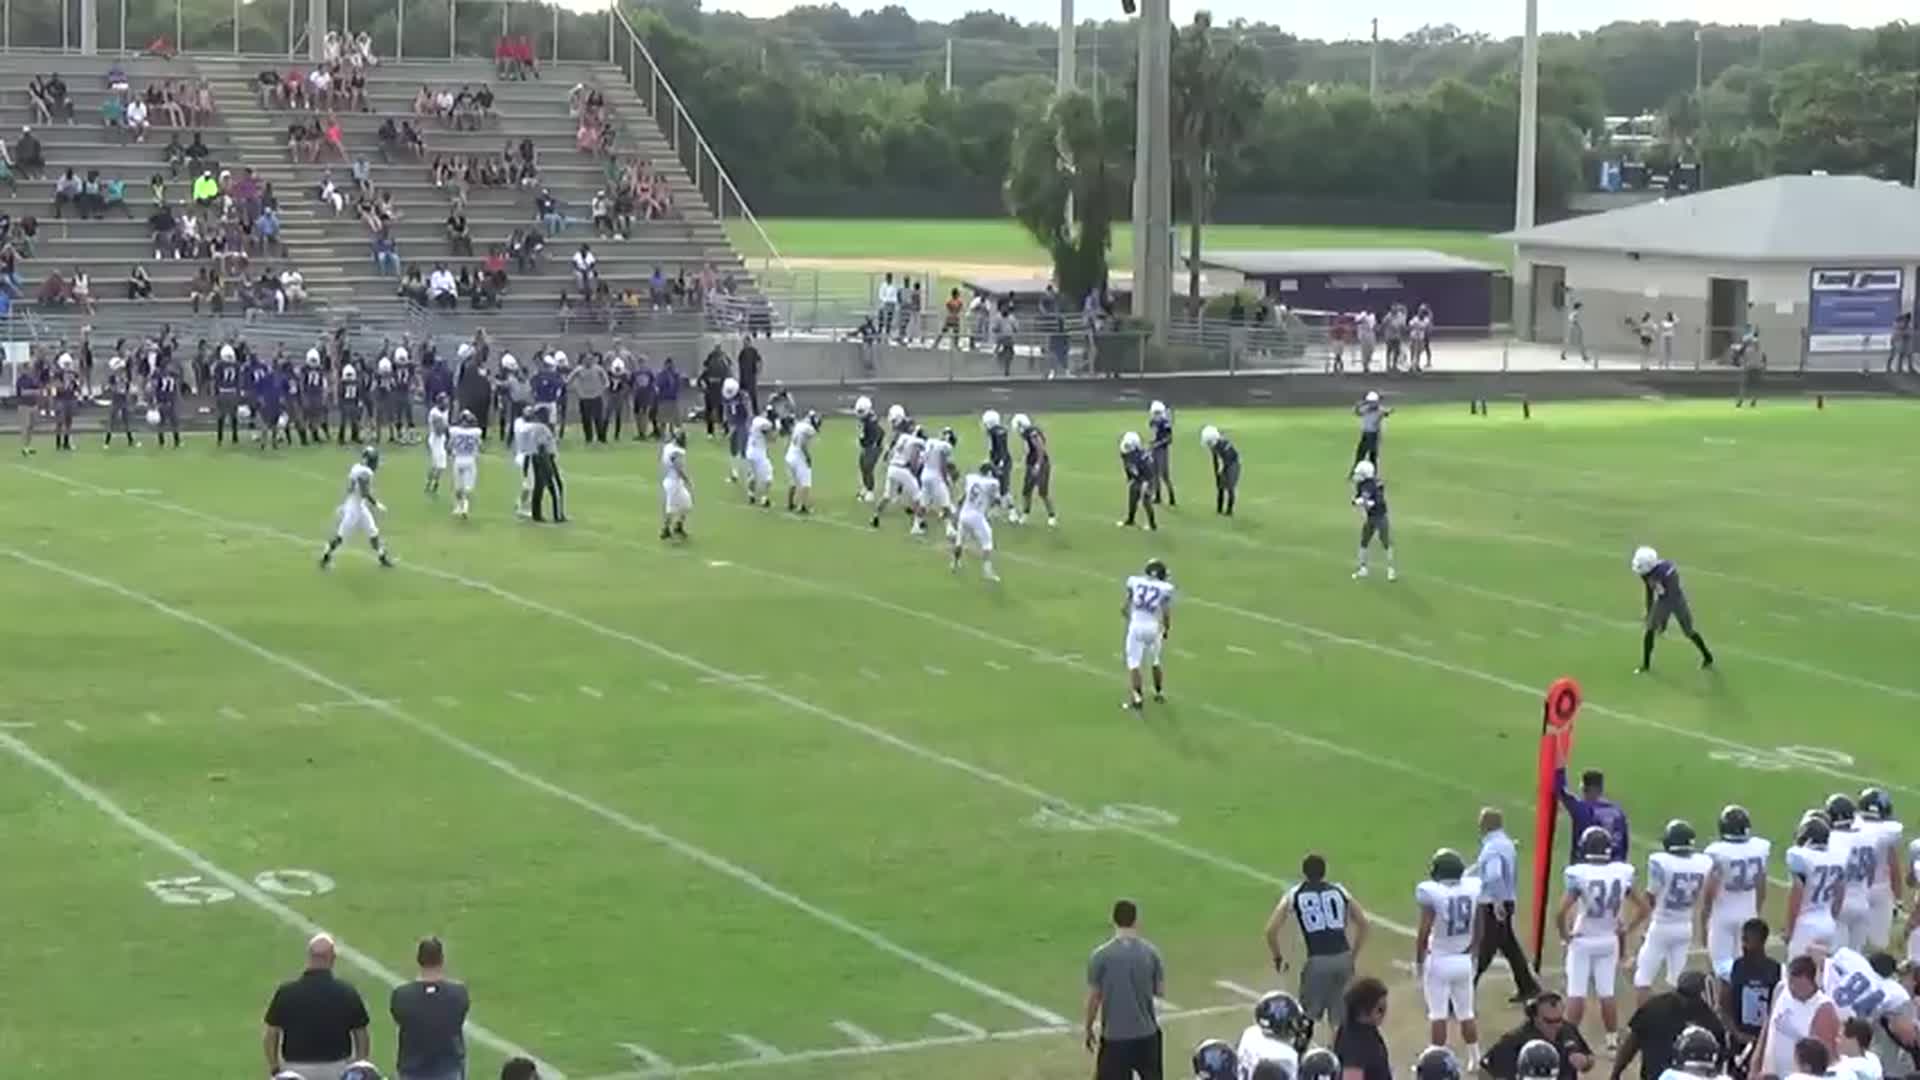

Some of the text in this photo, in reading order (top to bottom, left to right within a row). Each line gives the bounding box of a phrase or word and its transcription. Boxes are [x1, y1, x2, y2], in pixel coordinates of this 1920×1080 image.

[1135, 584, 1160, 613] 32
[145, 869, 336, 904] 50
[1298, 890, 1345, 933] 80
